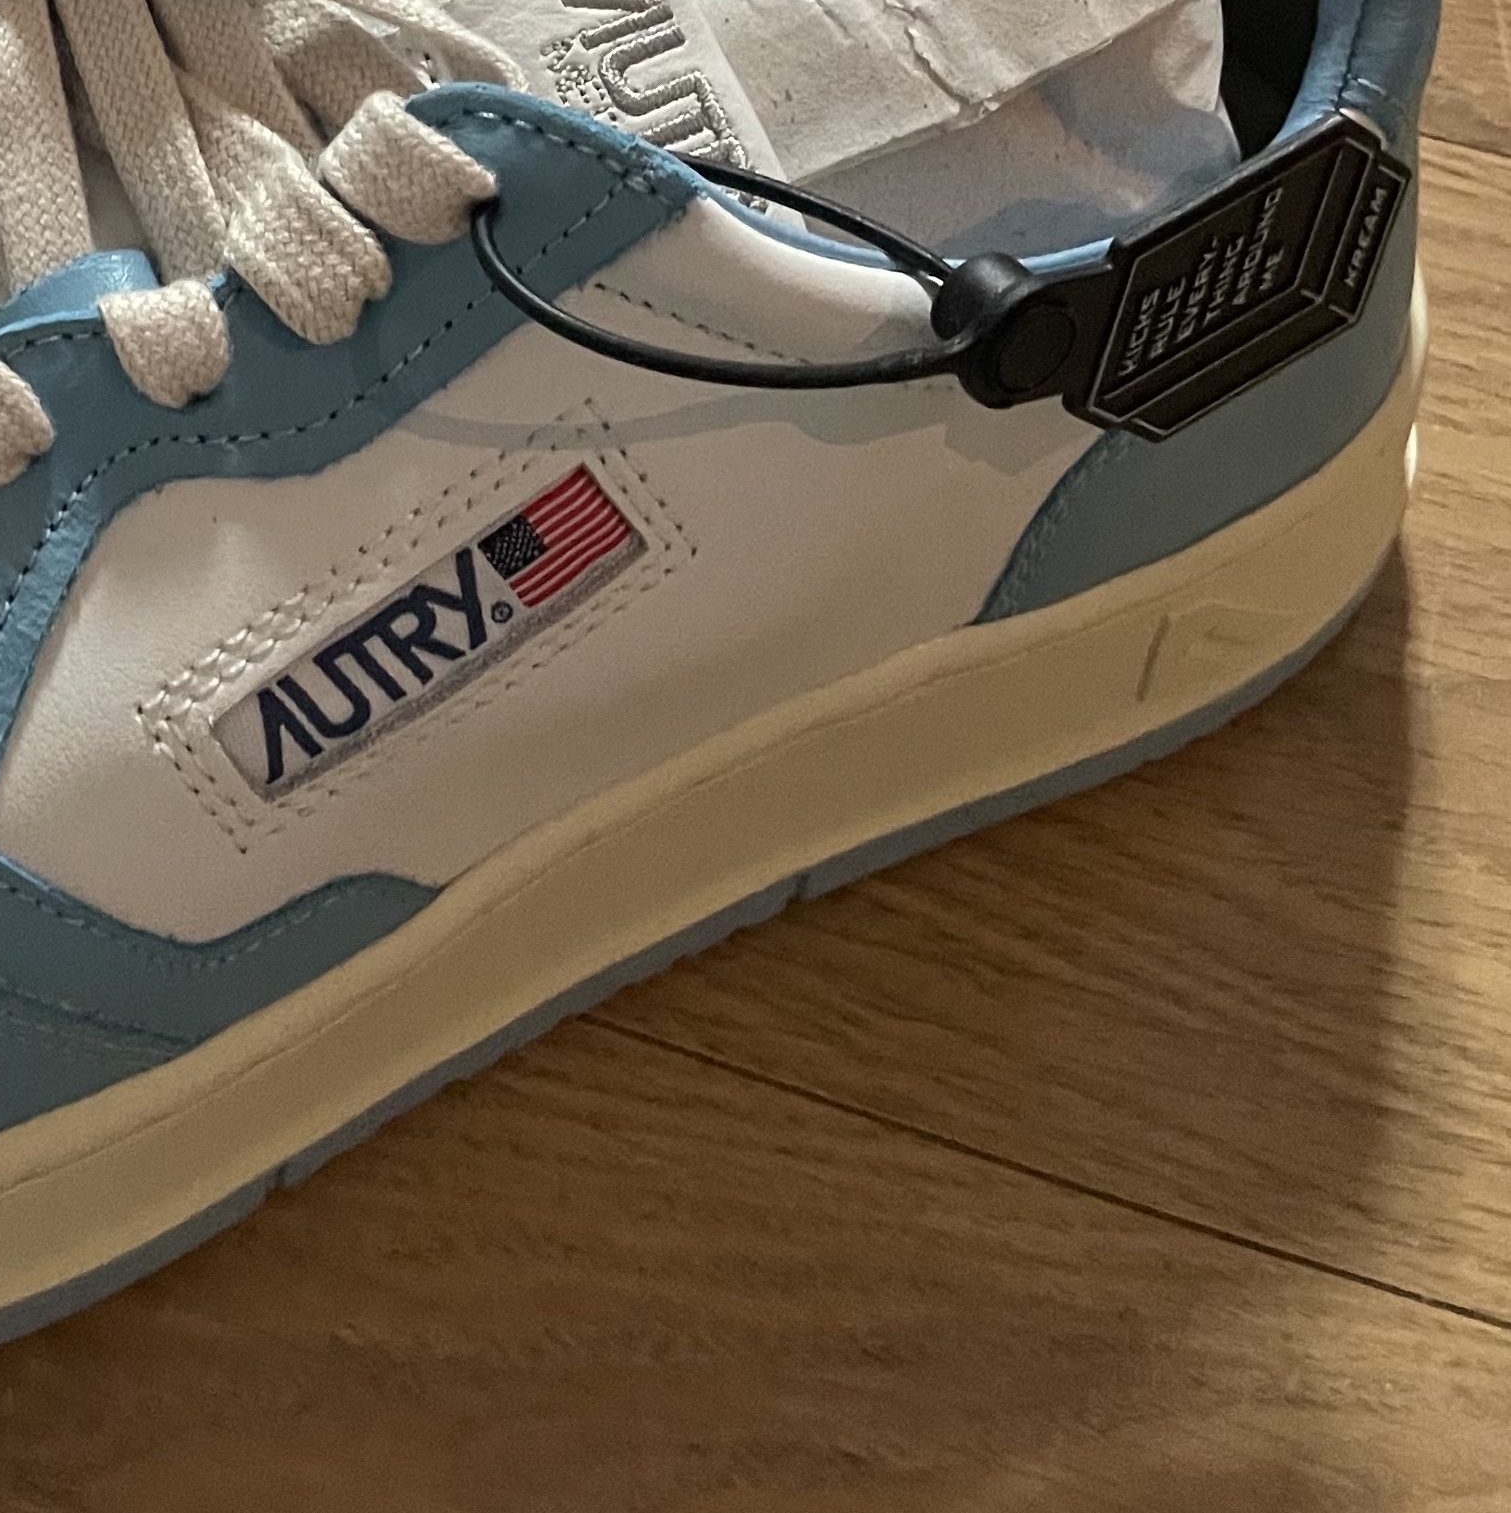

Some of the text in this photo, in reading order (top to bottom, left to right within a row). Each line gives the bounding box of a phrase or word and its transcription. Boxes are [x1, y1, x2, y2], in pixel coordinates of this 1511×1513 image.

[1201, 235, 1246, 329] THING
[1231, 186, 1284, 306] AROUND
[1259, 245, 1286, 292] ME
[1343, 187, 1388, 289] KREAM
[1118, 288, 1162, 377] KICKS
[1149, 275, 1187, 360] RULE
[257, 546, 488, 786] AUTRY
